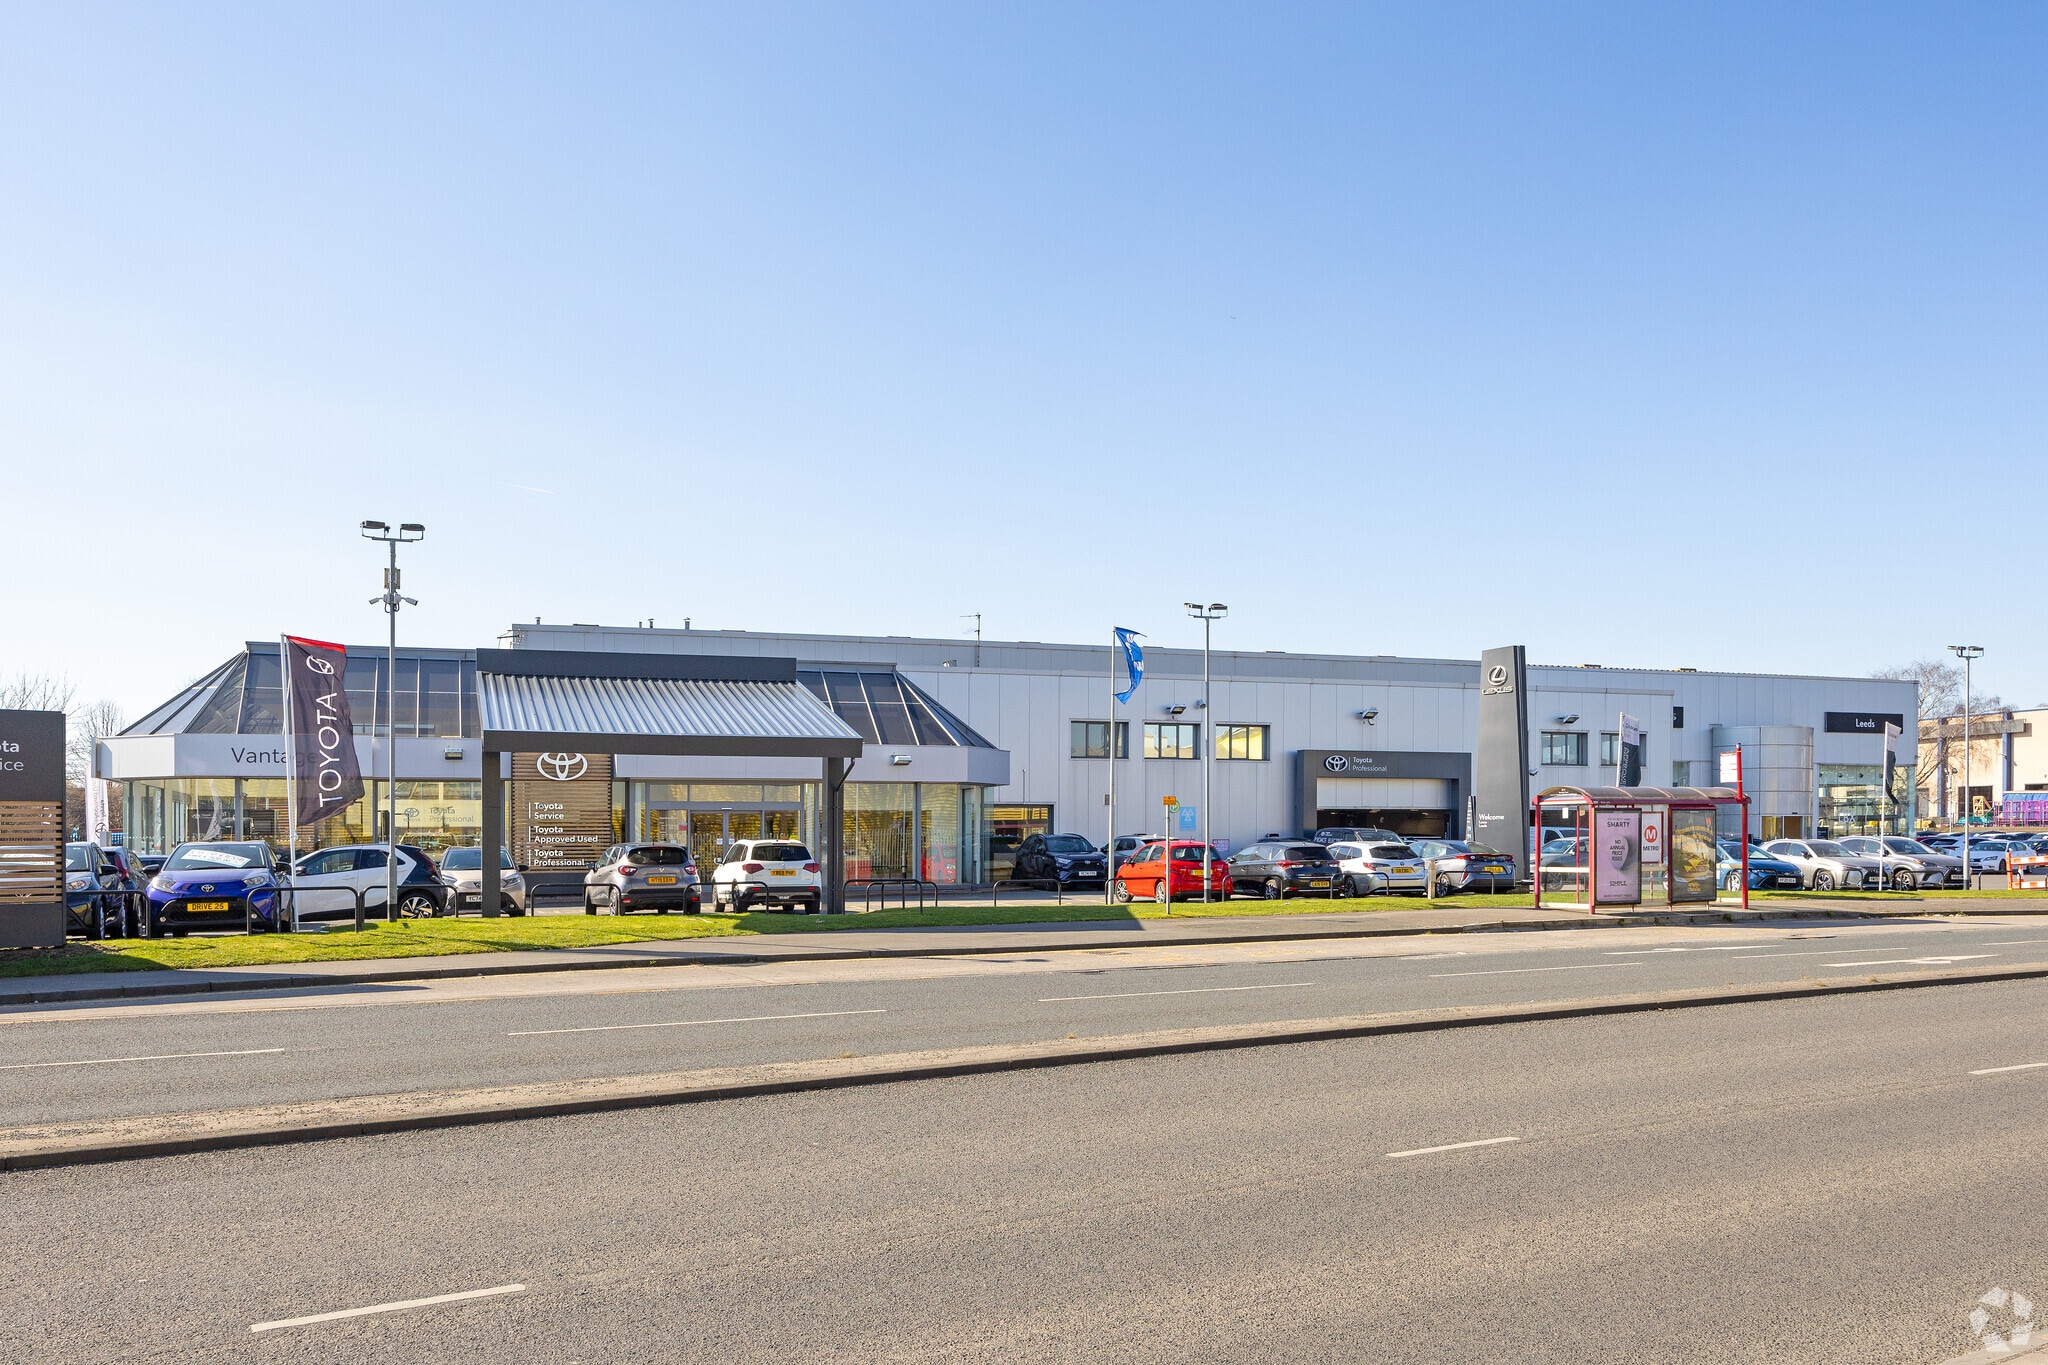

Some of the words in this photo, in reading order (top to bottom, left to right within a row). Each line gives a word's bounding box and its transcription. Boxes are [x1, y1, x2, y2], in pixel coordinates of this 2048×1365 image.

[1481, 686, 1514, 695] LEXUS
[1855, 718, 1875, 728] Leeds
[315, 692, 343, 808] TOYOTA
[1353, 756, 1372, 764] Toyota
[429, 807, 456, 815] Toyota
[533, 802, 563, 813] Toyota
[533, 812, 565, 820] Service
[1478, 813, 1505, 821] Welcome
[533, 825, 563, 835] Toyota
[533, 835, 575, 844] Approved
[533, 849, 563, 858] Toyota
[533, 859, 585, 867] Professional
[191, 903, 213, 911] DRIVE
[214, 902, 224, 910] 25
